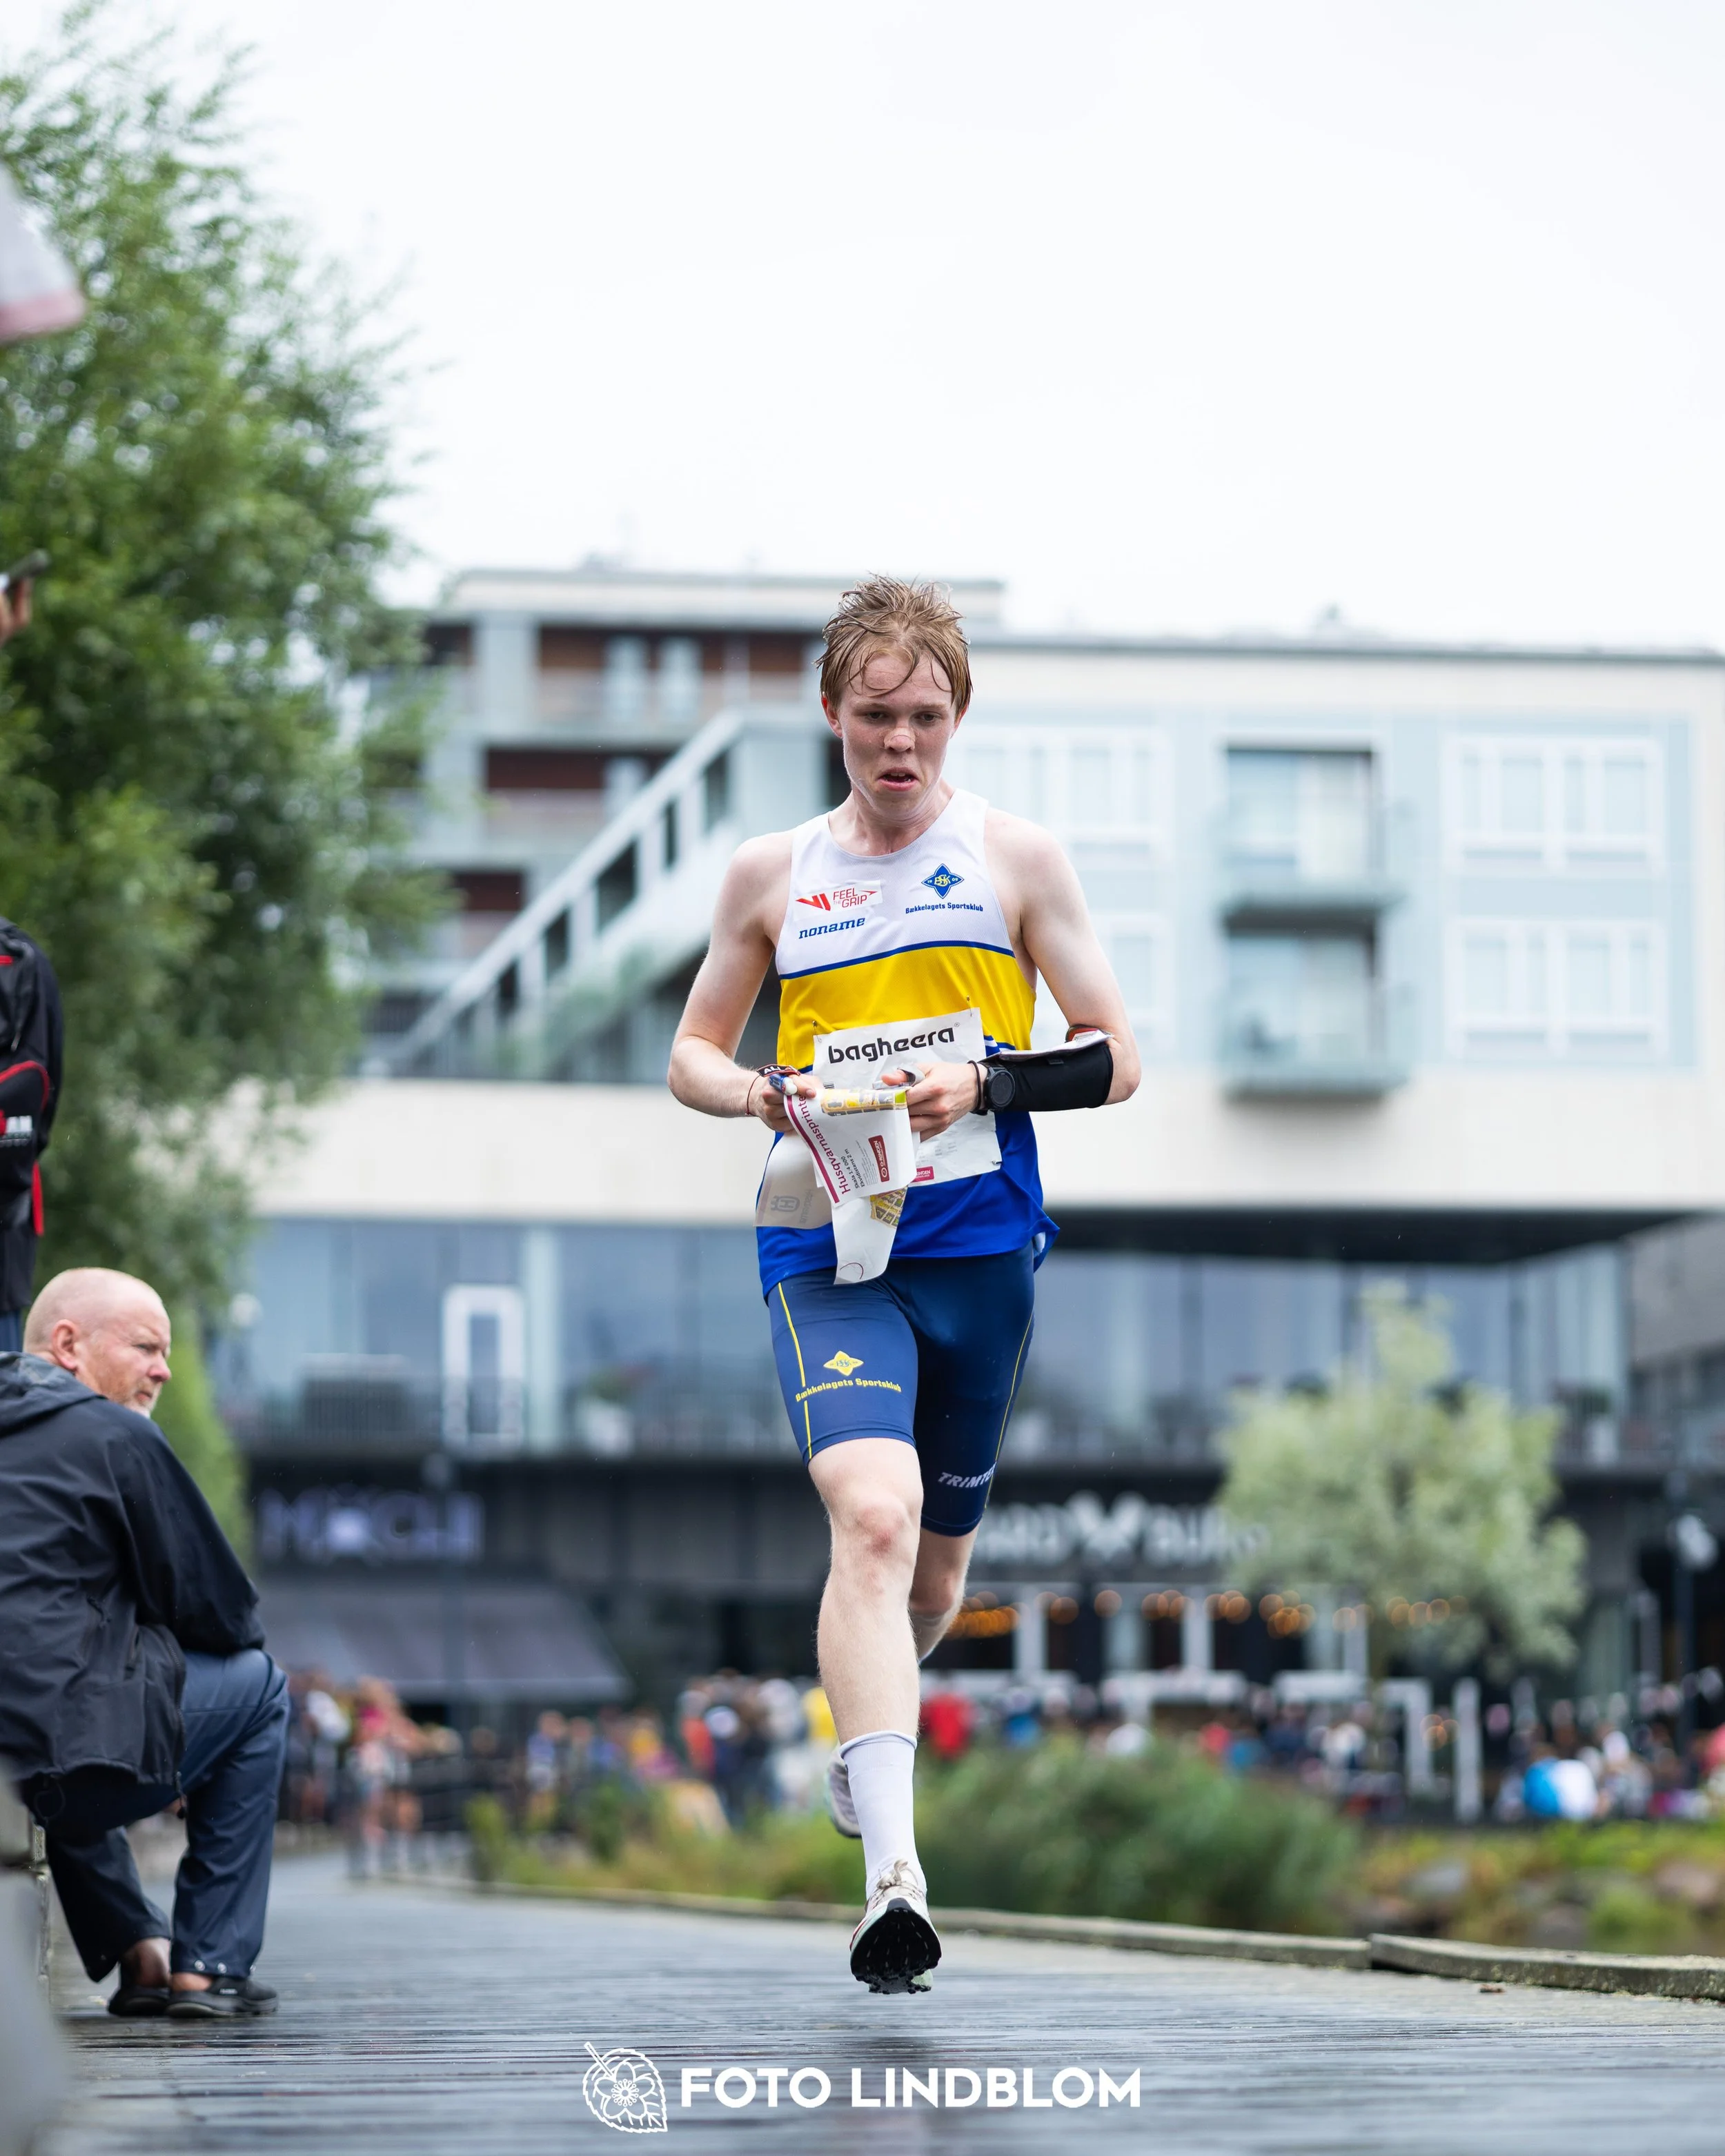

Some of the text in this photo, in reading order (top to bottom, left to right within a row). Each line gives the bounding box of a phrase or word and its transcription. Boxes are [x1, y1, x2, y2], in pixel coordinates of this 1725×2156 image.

[833, 888, 858, 900] FEEL
[841, 894, 867, 908] GRIP
[905, 902, 983, 914] Bækkelagets Sportsklub
[798, 918, 866, 939] noname
[828, 1027, 955, 1064] bagheera
[798, 1095, 851, 1194] Husqvarnasprinte
[850, 1158, 865, 1187] Ekvidistans
[851, 1175, 860, 1189] Skala
[795, 1378, 902, 1402] Bækkelagets Sportsklub
[938, 1461, 997, 1488] TRIMTE
